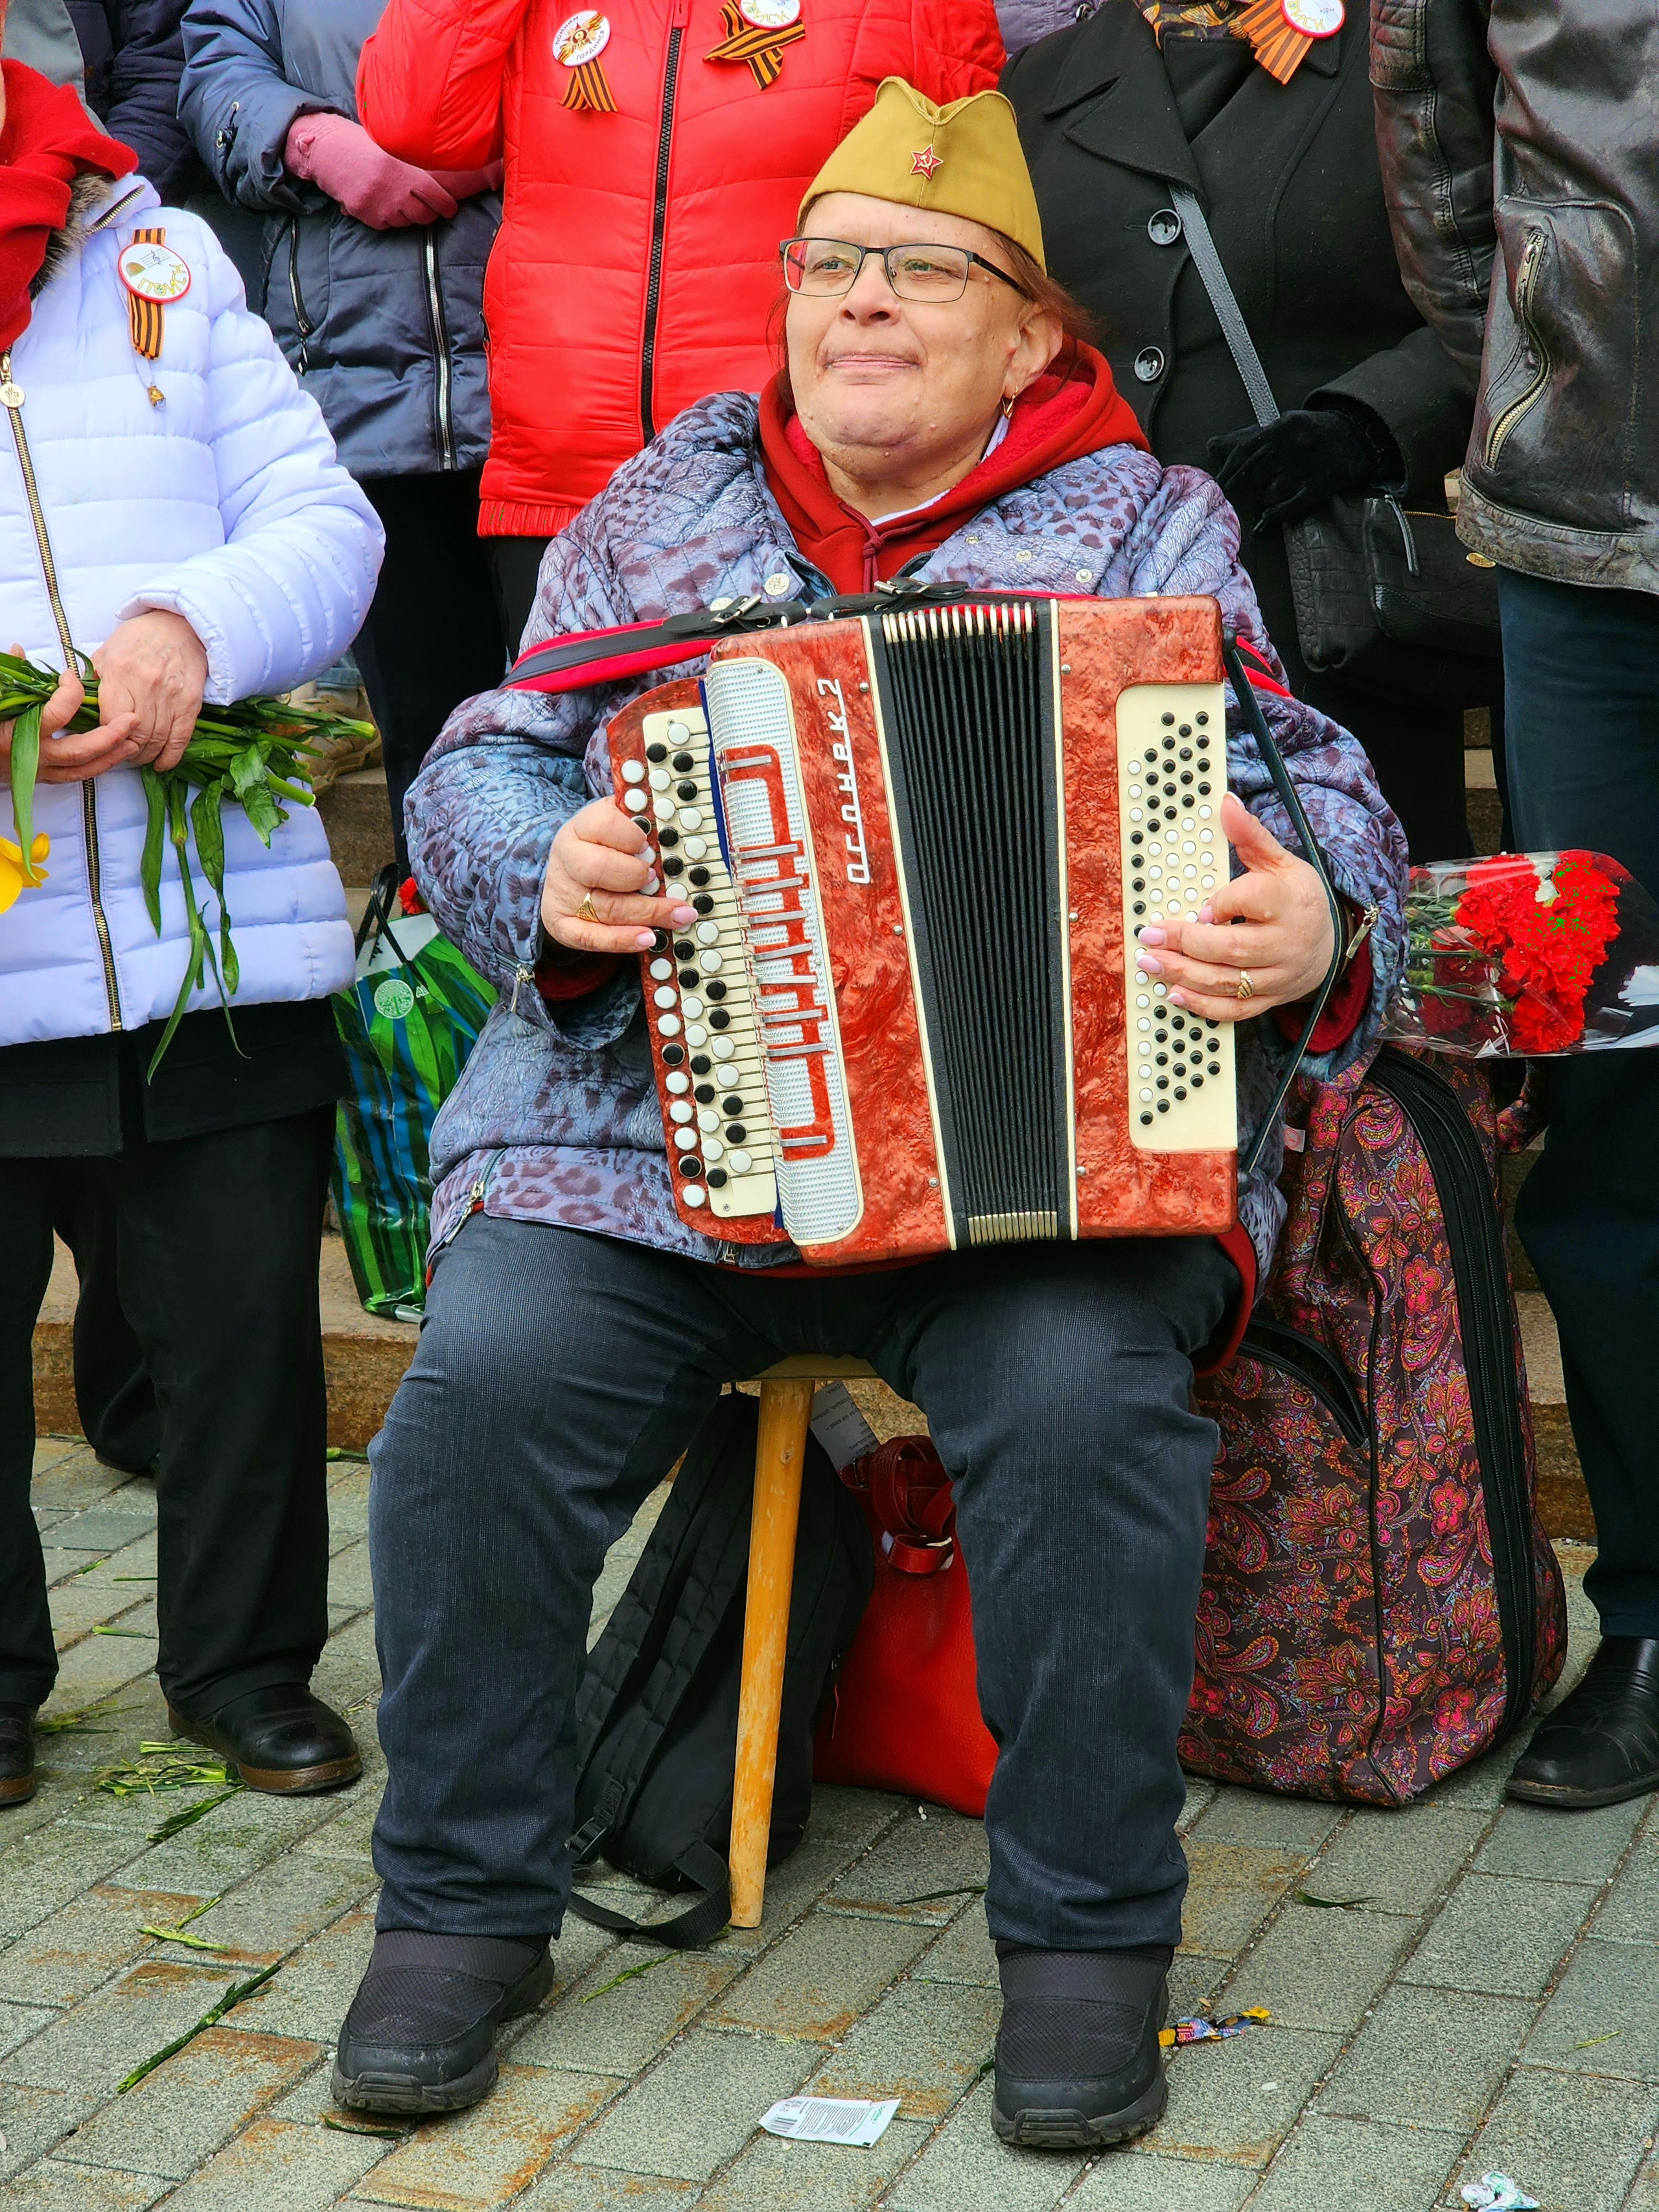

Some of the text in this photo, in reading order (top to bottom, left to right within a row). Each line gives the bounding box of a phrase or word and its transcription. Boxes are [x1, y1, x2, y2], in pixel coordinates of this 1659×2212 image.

[555, 16, 579, 45] ПОМНИМ
[572, 29, 587, 44] 9
[575, 38, 590, 49] МАЯ
[576, 30, 605, 61] ГОРДИМСЯ
[137, 264, 187, 296] ПОИСК
